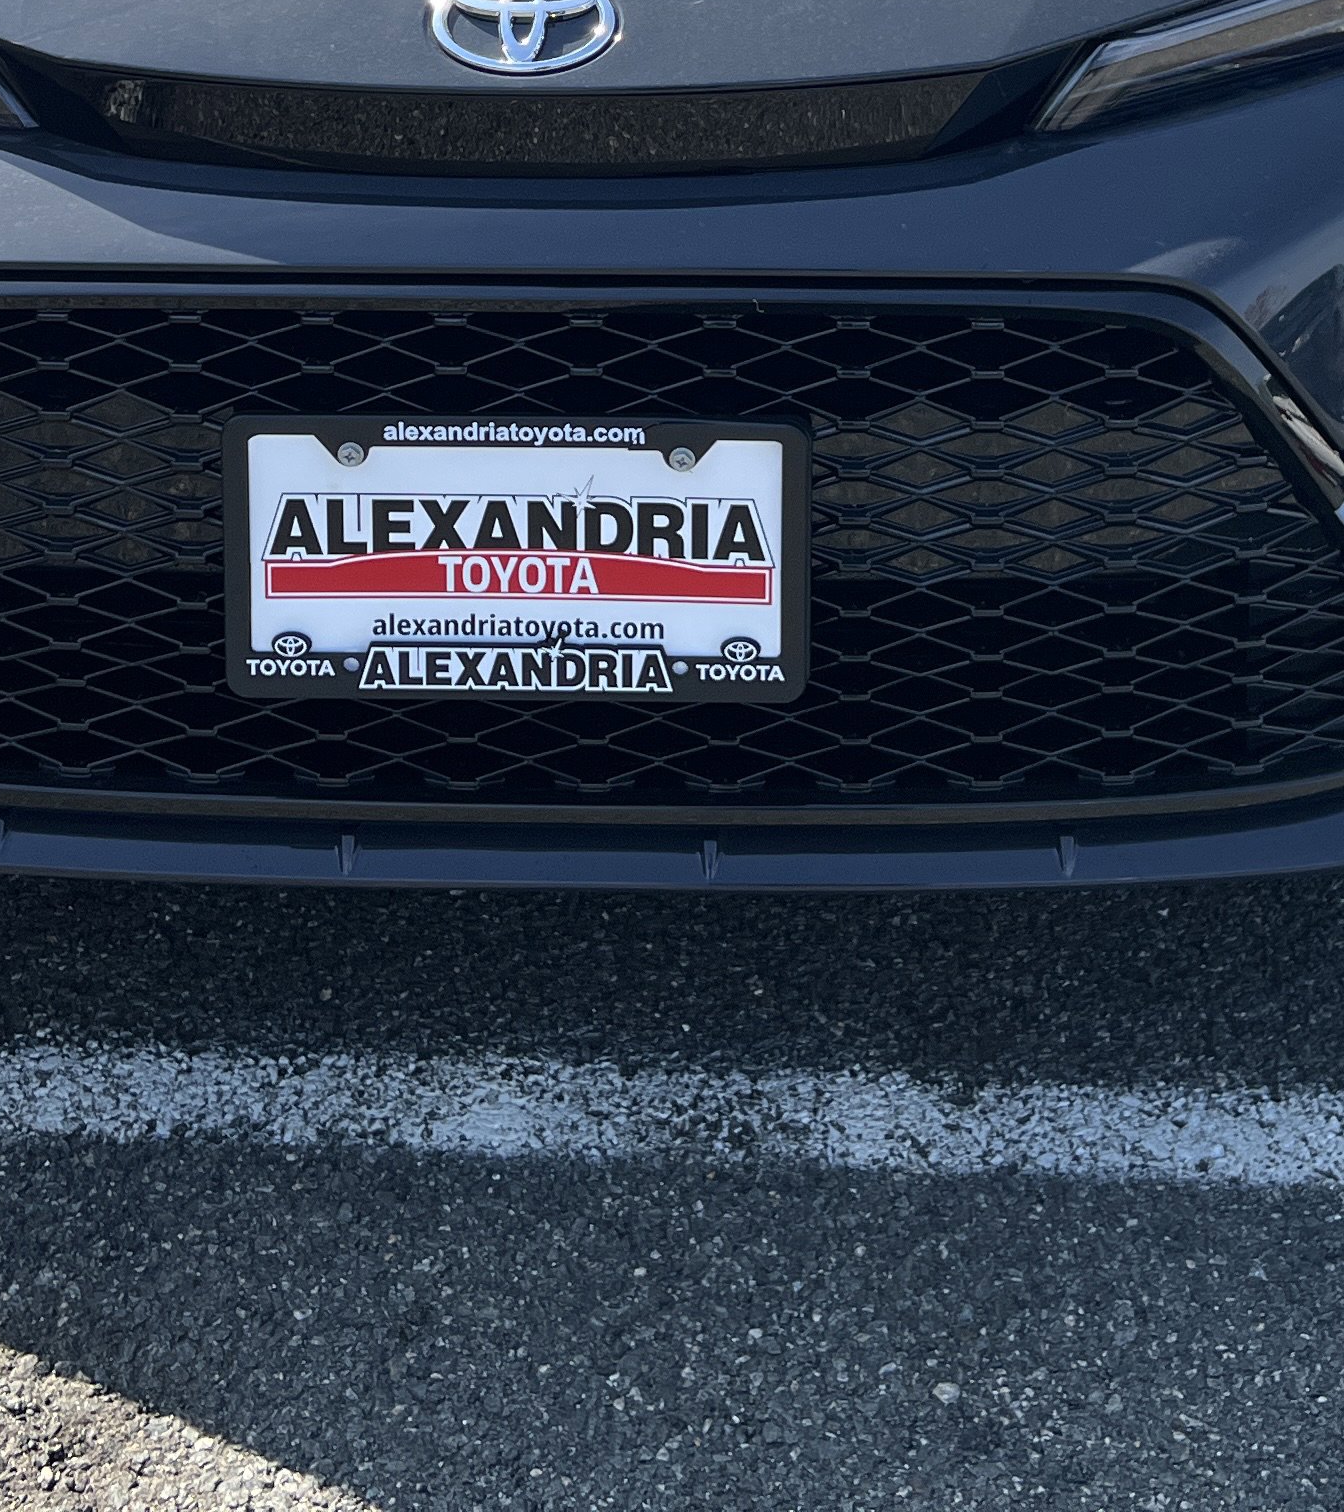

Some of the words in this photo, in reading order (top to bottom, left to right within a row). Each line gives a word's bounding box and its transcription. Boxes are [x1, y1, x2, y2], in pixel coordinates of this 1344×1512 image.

[382, 421, 646, 447] alexandriatoyota.com
[267, 494, 765, 564] ALEXANDRIA
[438, 554, 599, 595] TOYOTA
[371, 613, 665, 642] alexandriatoyota.com
[246, 659, 336, 677] TOYOTA
[360, 646, 673, 692] ALEXANDRIA
[695, 663, 786, 682] TOYOTA
